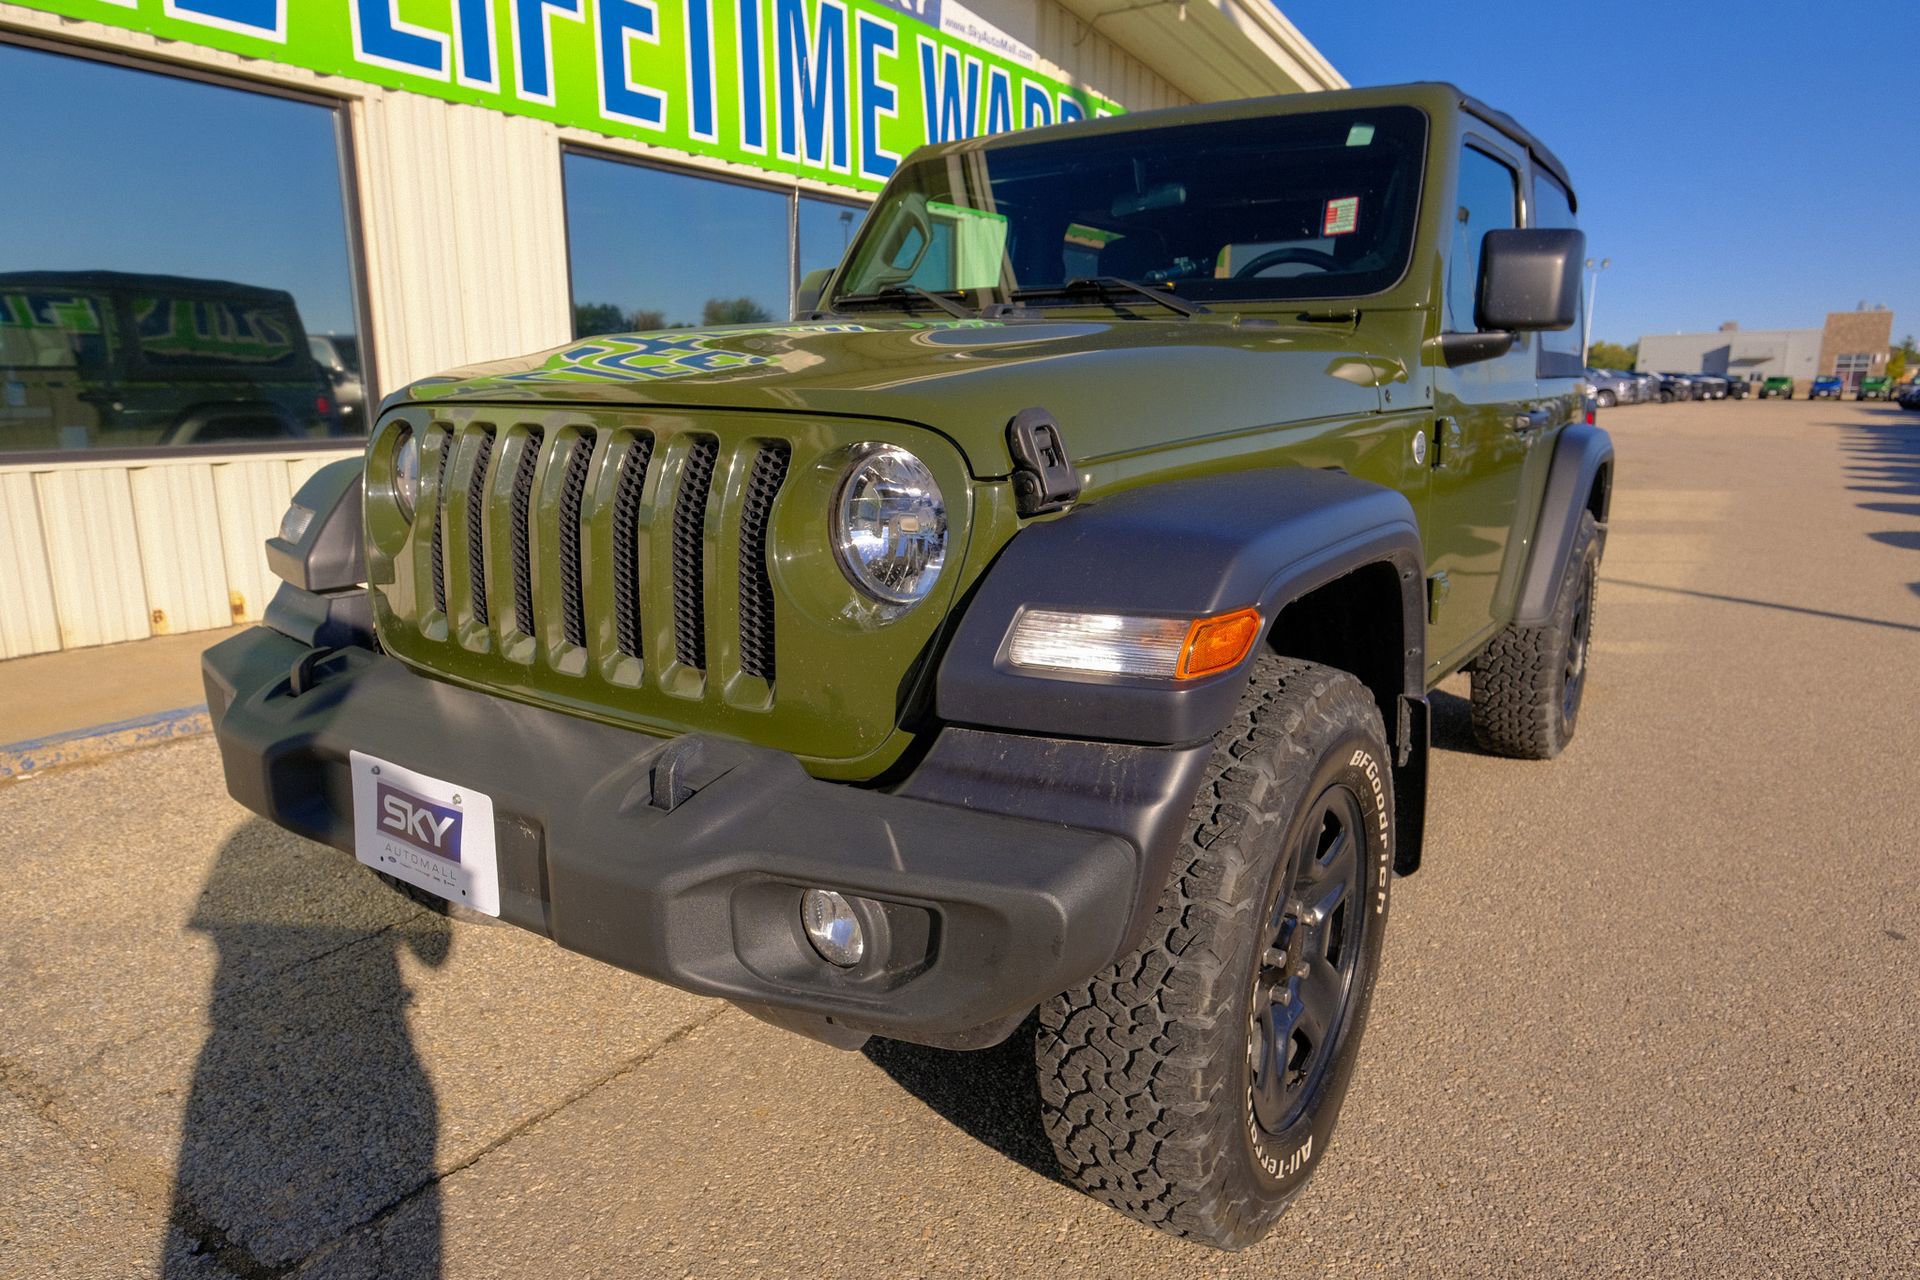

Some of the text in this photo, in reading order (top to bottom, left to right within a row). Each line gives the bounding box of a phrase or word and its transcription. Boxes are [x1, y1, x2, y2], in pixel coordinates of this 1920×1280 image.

[382, 793, 455, 848] SKY
[1350, 749, 1388, 914] BFGoodrich
[385, 842, 457, 880] AUTOMALL
